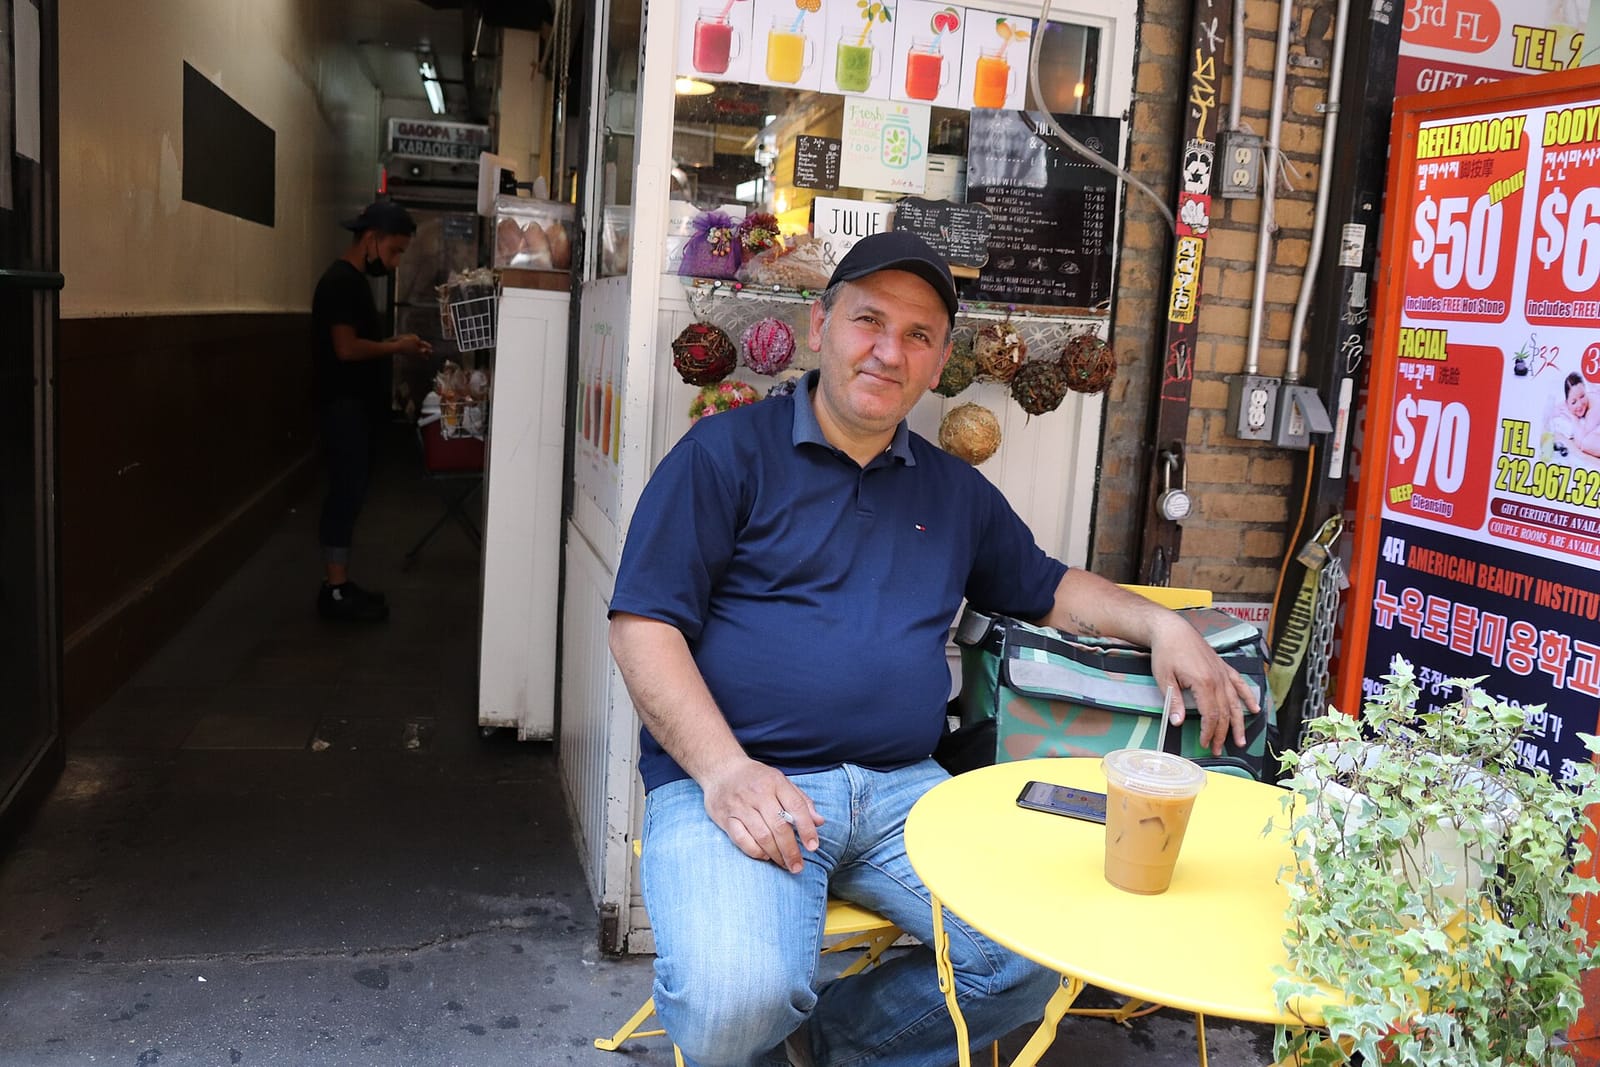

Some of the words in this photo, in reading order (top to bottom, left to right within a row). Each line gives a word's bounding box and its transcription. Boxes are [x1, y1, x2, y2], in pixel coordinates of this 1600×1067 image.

[1401, 0, 1447, 32] 3rd
[1453, 10, 1489, 43] FL
[1513, 25, 1564, 72] TEL.
[1416, 68, 1468, 92] GIFT
[849, 104, 882, 120] Fresh
[1541, 104, 1600, 149] BODY
[398, 123, 450, 140] GAGOPA
[1416, 114, 1527, 159] REFLEXOLOGY
[399, 139, 458, 157] KARAOKE
[1417, 161, 1460, 191] 발마사지
[1544, 147, 1600, 182] 전신마사
[1487, 168, 1526, 207] 1Hour
[829, 208, 880, 237] JULIE
[823, 241, 837, 267] &
[1412, 194, 1503, 291] $50
[1406, 296, 1441, 312] includes
[1442, 298, 1461, 312] FREE
[1462, 298, 1477, 313] Hot
[1478, 299, 1505, 315] Stone
[1528, 300, 1571, 317] includes
[1573, 301, 1596, 317] FREE
[1398, 327, 1448, 361] FACIAL
[1586, 347, 1600, 375] 3
[1393, 393, 1471, 494] $70
[1502, 418, 1535, 458] TEL.
[1389, 483, 1414, 504] DEEP
[1495, 455, 1600, 509] 212.967.32
[1411, 493, 1453, 518] Cleansing
[1501, 502, 1519, 516] GIFT
[1519, 506, 1570, 528] CERTIFICATE
[1490, 520, 1520, 538] COUPLE
[1520, 527, 1548, 545] ROOMS
[1547, 534, 1567, 549] ARE
[1382, 535, 1406, 566] 4FL
[1407, 545, 1476, 587] AMERICAN
[1477, 563, 1535, 601] BEAUTY
[1535, 578, 1600, 622] INSTITU
[1216, 606, 1271, 622] RINKLER
[1373, 578, 1600, 699] 뉴욕토탈미용학교
